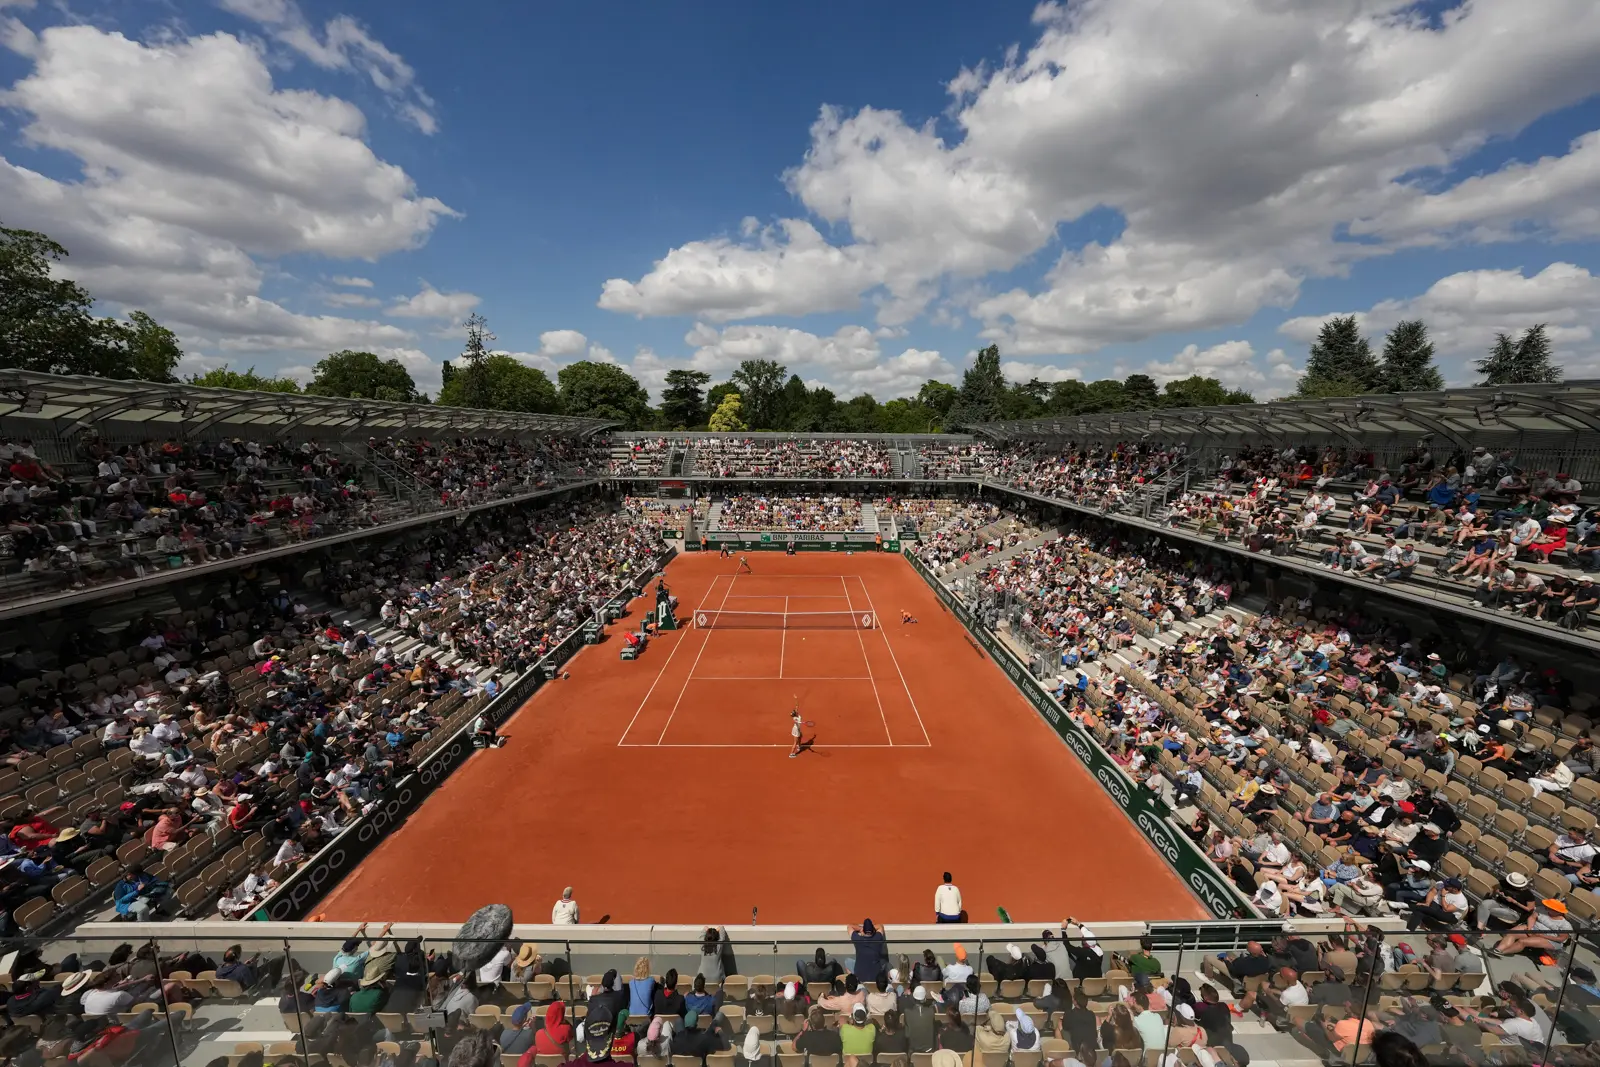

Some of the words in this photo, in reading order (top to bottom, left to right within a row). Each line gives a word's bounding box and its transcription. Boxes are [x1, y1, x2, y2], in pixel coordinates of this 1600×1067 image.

[491, 694, 518, 722] Emirates
[1021, 678, 1042, 704] Emirates
[1046, 705, 1061, 725] BETTER
[421, 743, 461, 785] oppo
[357, 788, 412, 842] oppo
[269, 850, 345, 921] oppo
